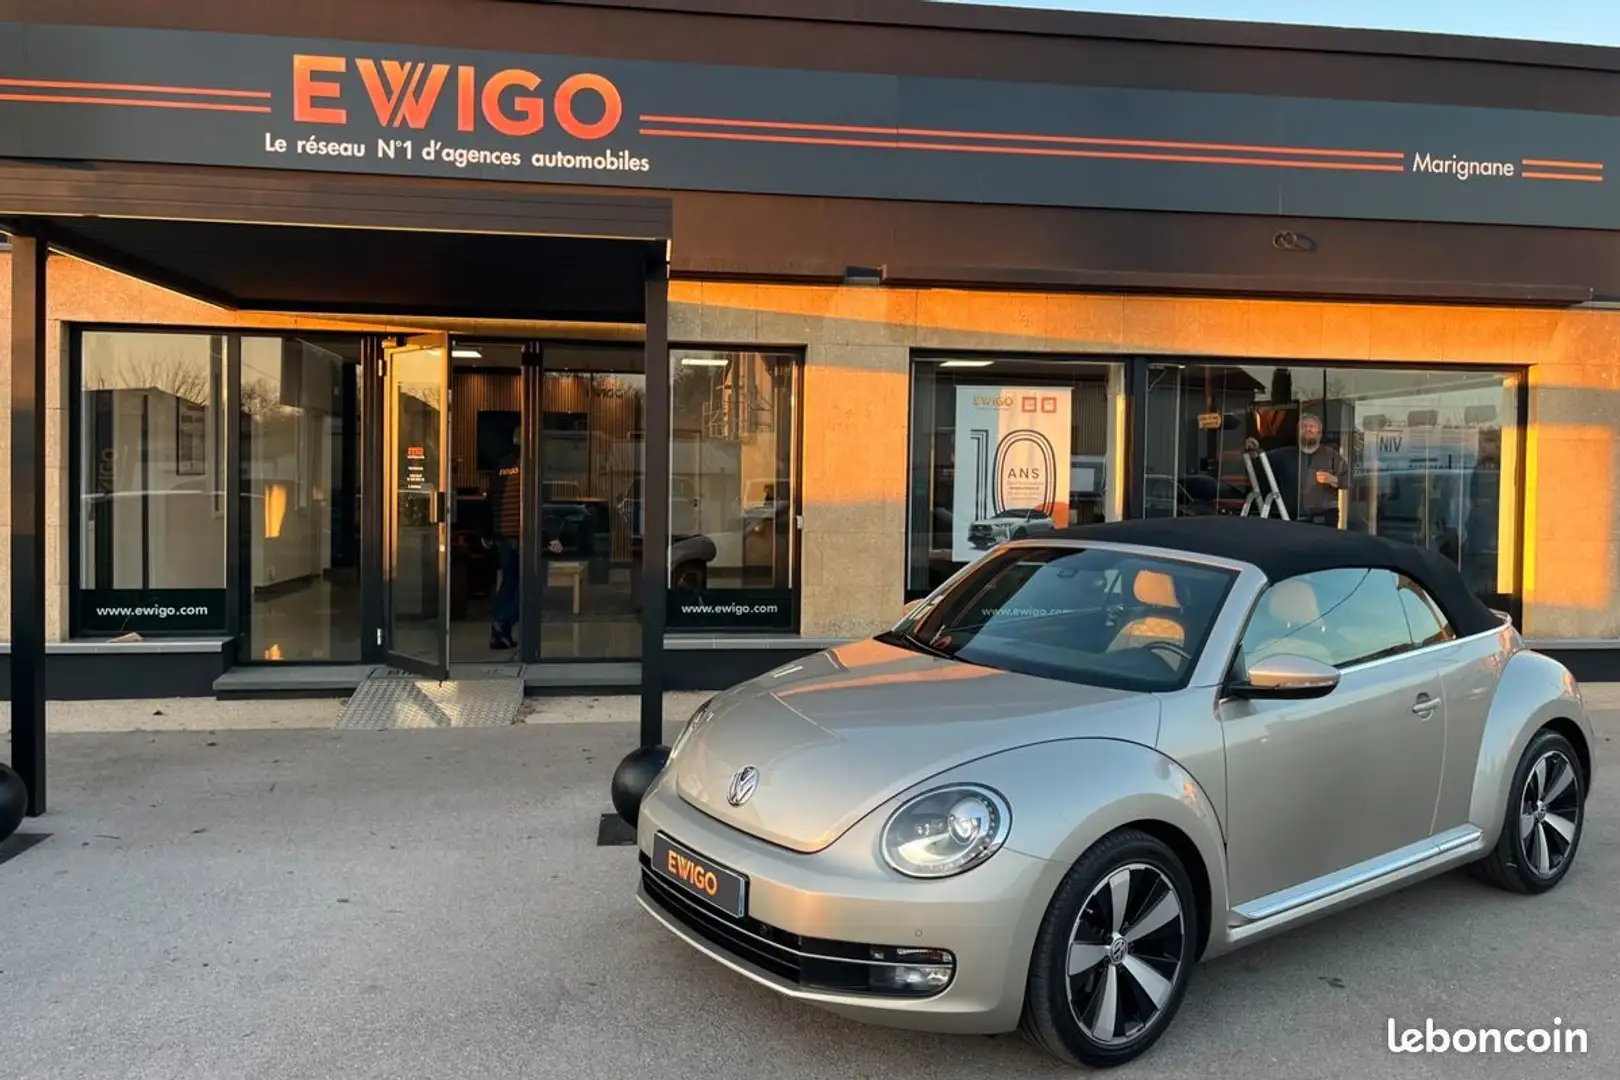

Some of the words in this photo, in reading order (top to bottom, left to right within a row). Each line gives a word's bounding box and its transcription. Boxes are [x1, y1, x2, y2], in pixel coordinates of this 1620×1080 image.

[293, 54, 623, 140] EWIGO
[264, 132, 288, 153] Le
[296, 135, 366, 158] réseau
[421, 140, 522, 168] d'agences
[531, 149, 650, 172] automobiles
[1412, 152, 1515, 181] Marignane
[1007, 467, 1040, 480] ANS
[96, 603, 208, 619] www.ewigo.com
[681, 602, 778, 616] www.ewigo.com
[981, 605, 1074, 617] www.ewigo.co
[668, 849, 718, 896] EWIGO
